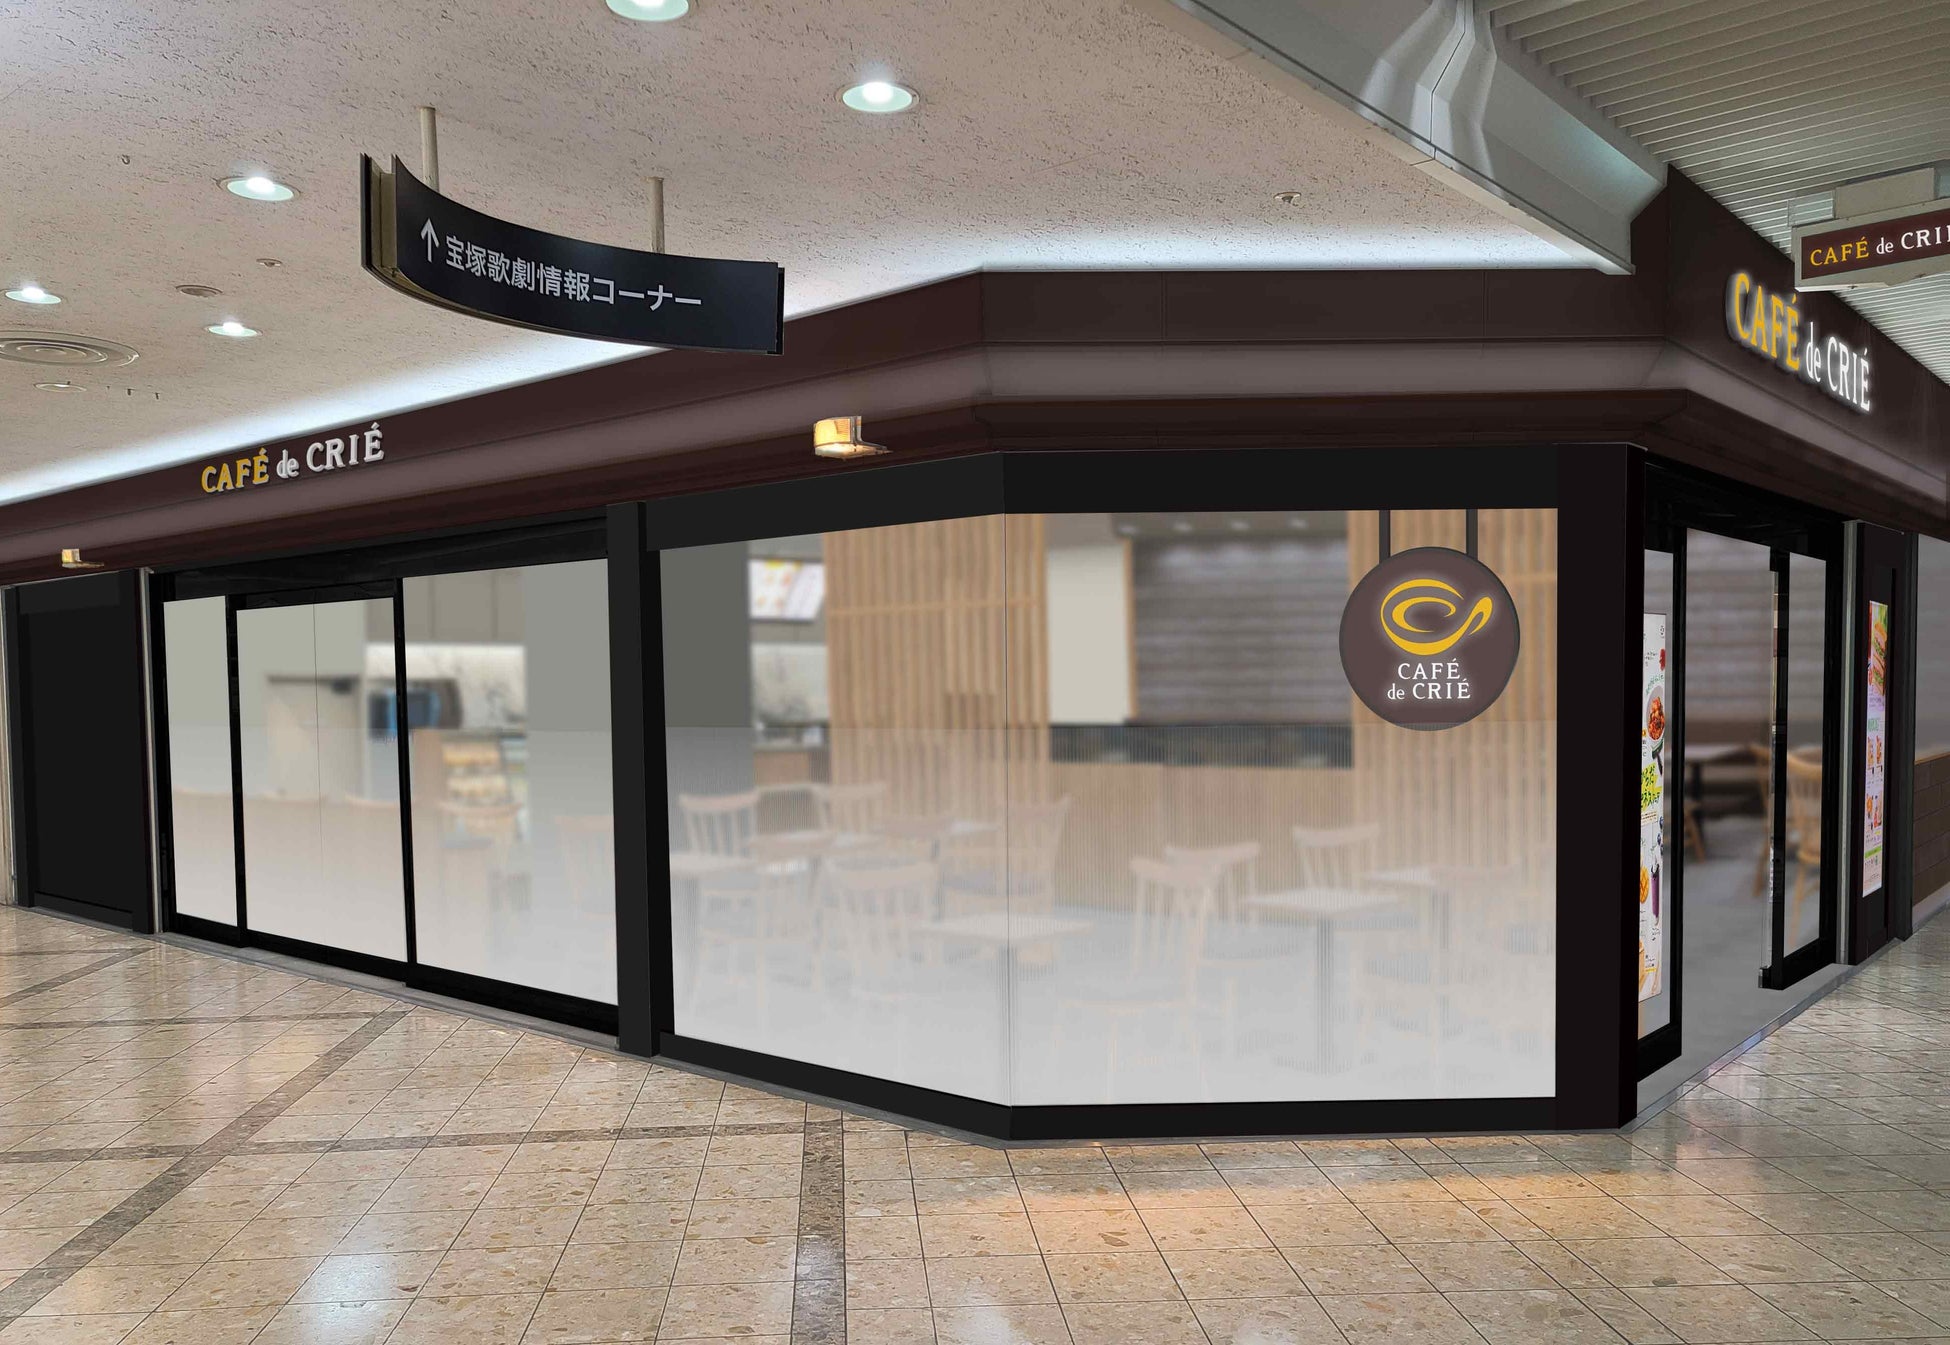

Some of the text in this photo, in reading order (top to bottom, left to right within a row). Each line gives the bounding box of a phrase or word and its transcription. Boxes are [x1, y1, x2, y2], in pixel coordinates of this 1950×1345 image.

[445, 235, 702, 312] 宝塚歌劇情報コーナー
[1810, 236, 1870, 266] CAFÉ
[1876, 237, 1894, 255] de
[1734, 272, 1871, 412] CAFÉ de CRIÉ
[201, 421, 385, 493] CAFÉ de CRIÉ
[1387, 678, 1471, 700] de CRIÉ
[1397, 658, 1461, 680] CAFÉ
